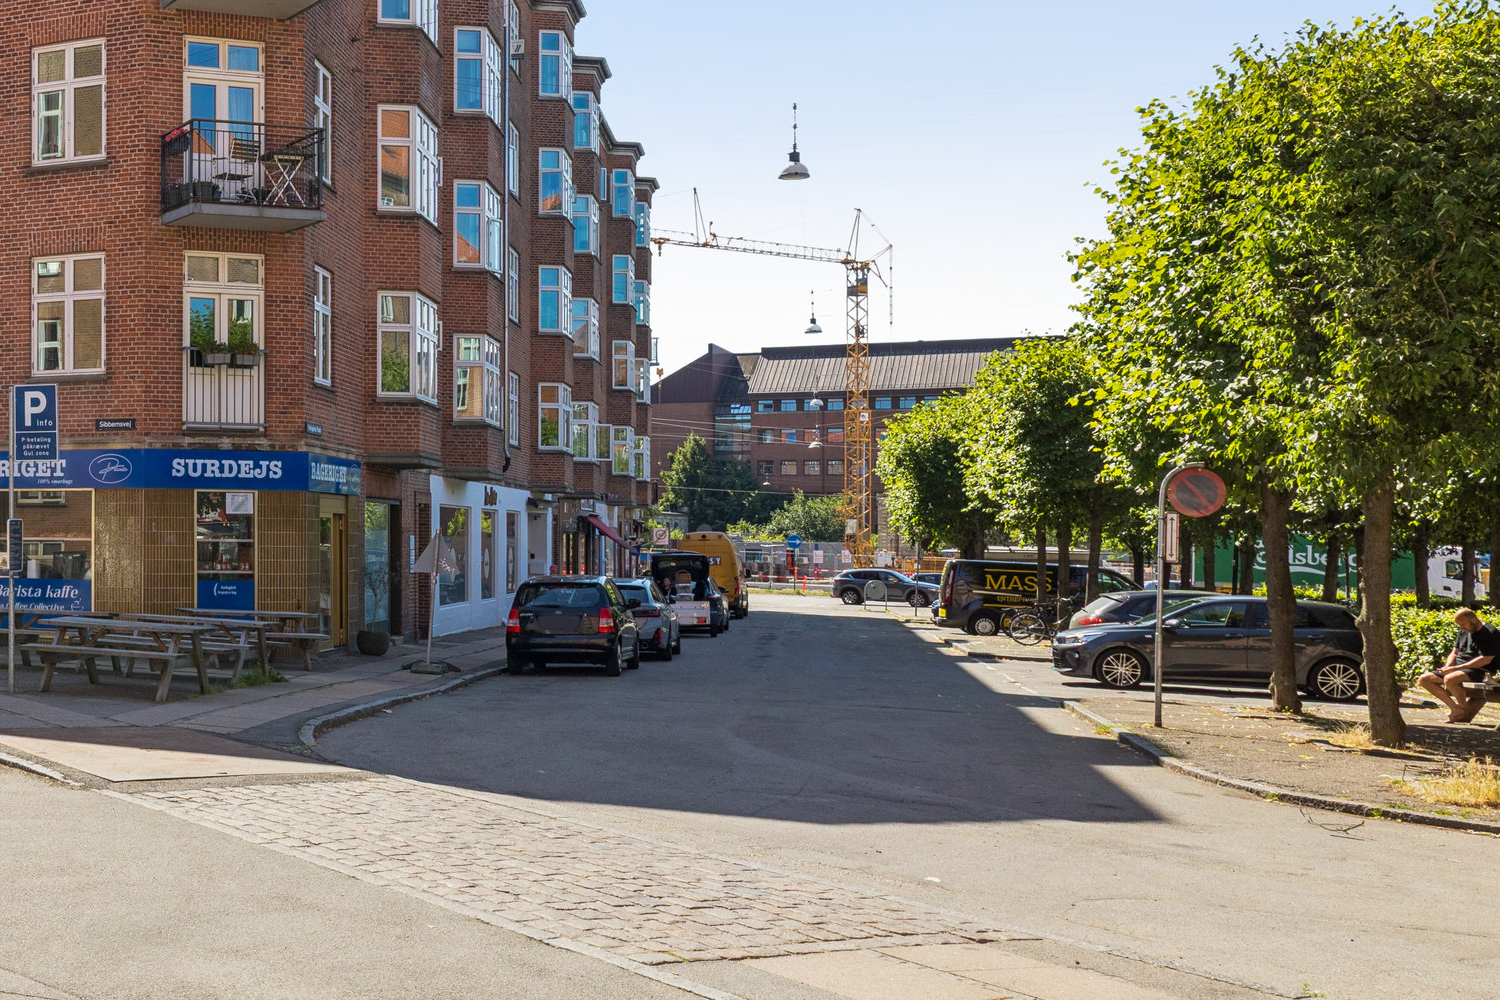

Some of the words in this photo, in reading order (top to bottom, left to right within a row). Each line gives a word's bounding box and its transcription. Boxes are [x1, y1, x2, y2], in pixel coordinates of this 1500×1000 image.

[24, 391, 47, 427] P
[172, 458, 283, 479] SURDEJS
[46, 585, 79, 599] kaffe
[29, 602, 65, 611] Collective
